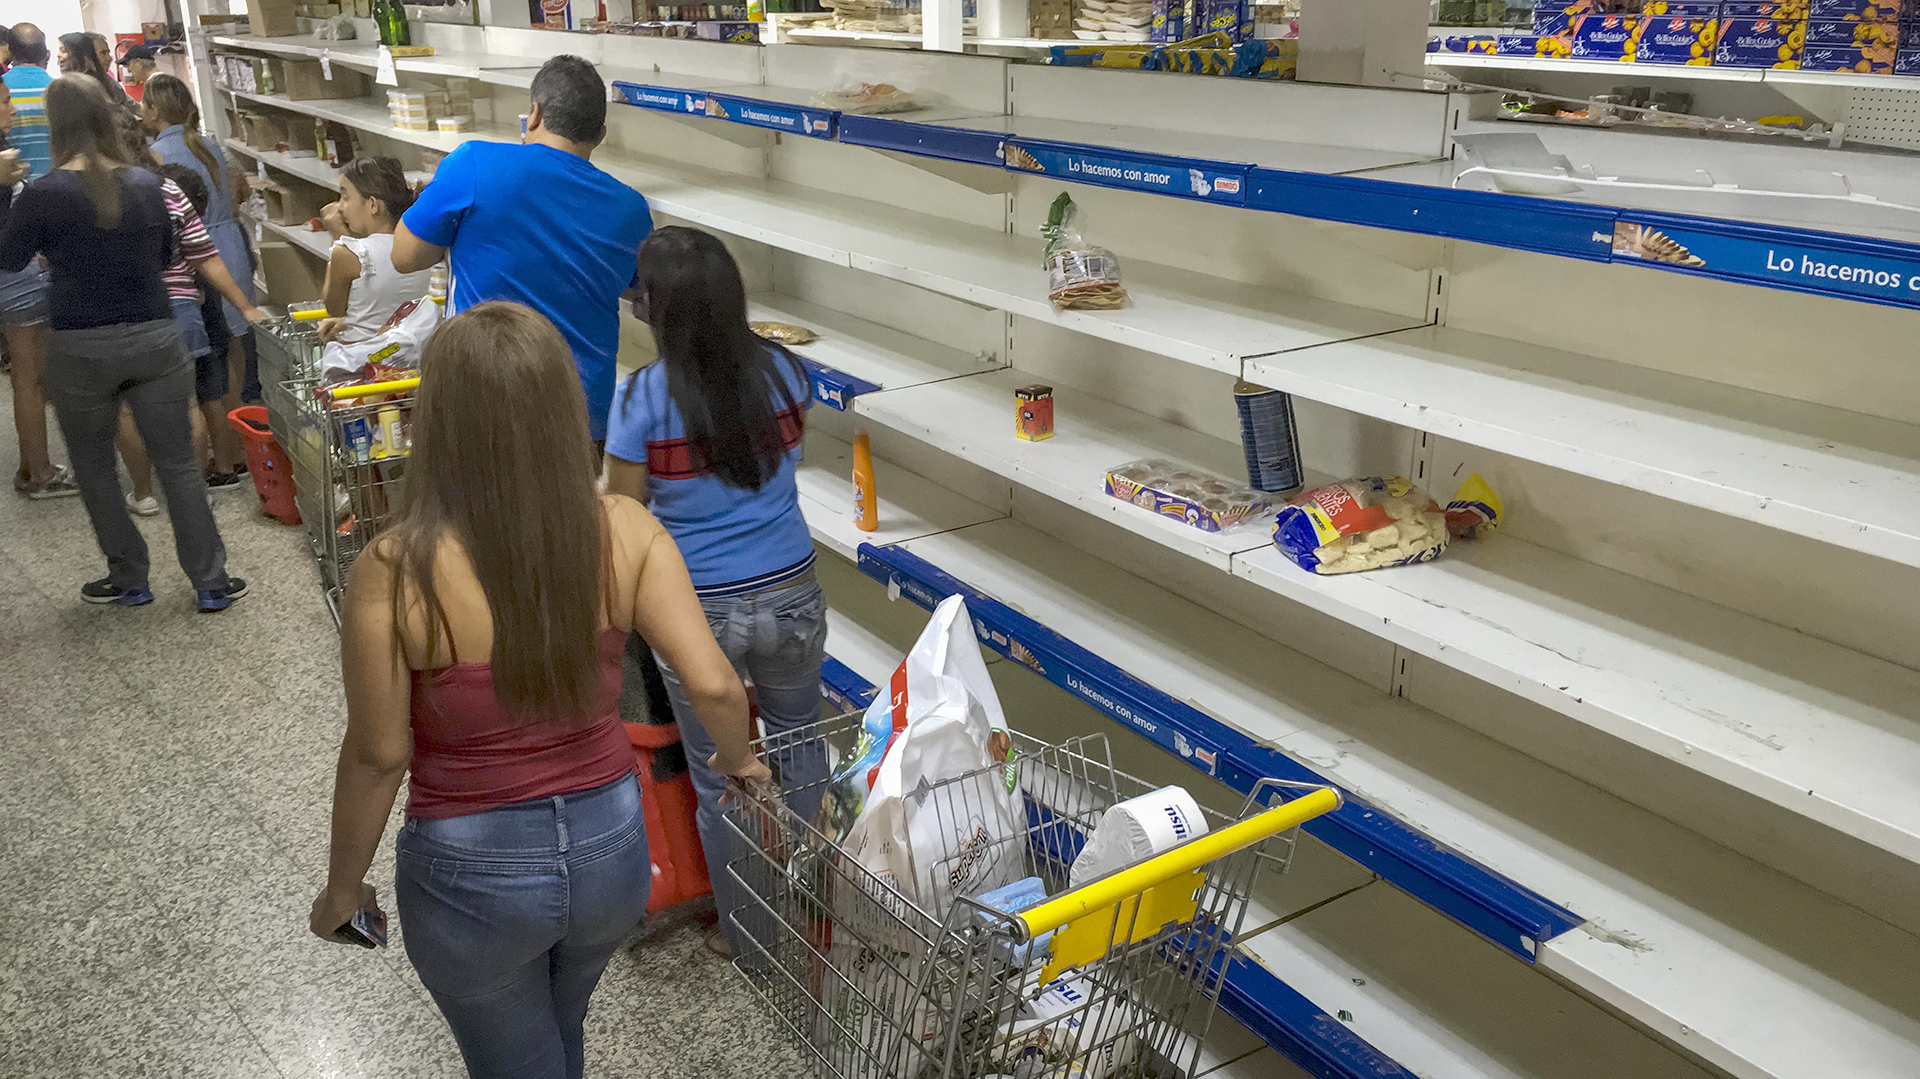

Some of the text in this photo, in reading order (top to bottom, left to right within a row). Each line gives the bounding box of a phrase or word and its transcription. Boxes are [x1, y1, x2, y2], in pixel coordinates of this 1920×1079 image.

[741, 108, 795, 126] Lo hacemos con amor
[1068, 158, 1170, 185] Lo hacemos con amor
[1766, 250, 1794, 272] Lo
[1801, 253, 1901, 288] hacemos
[907, 582, 934, 604] hacemos
[1066, 674, 1158, 734] Lo hacemos con amor
